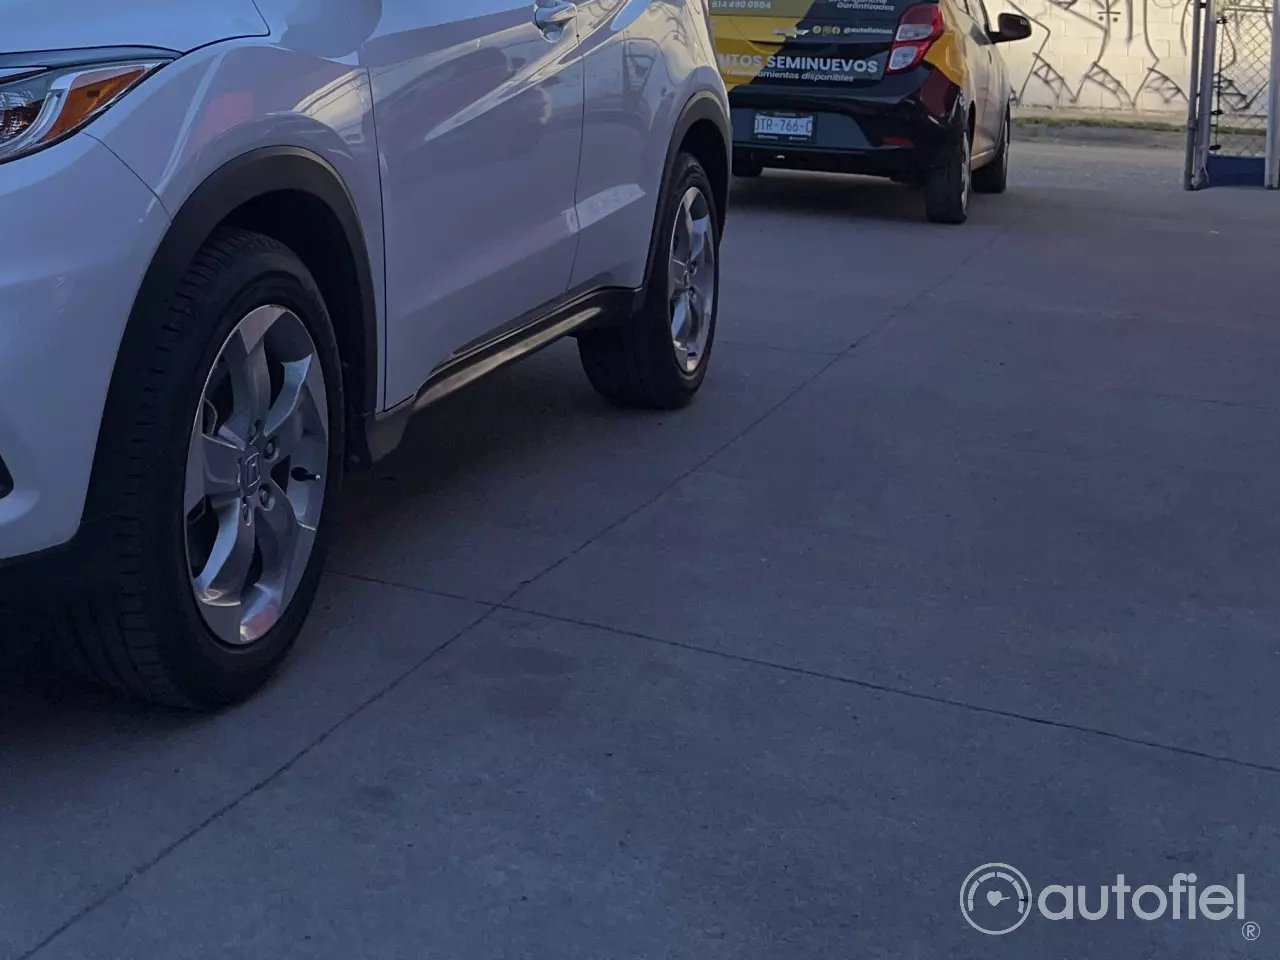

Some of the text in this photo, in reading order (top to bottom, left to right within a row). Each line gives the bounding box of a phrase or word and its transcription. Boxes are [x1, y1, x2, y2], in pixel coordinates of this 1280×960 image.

[716, 52, 878, 73] UTOS SEMINUEVOS
[801, 71, 854, 82] disponibles
